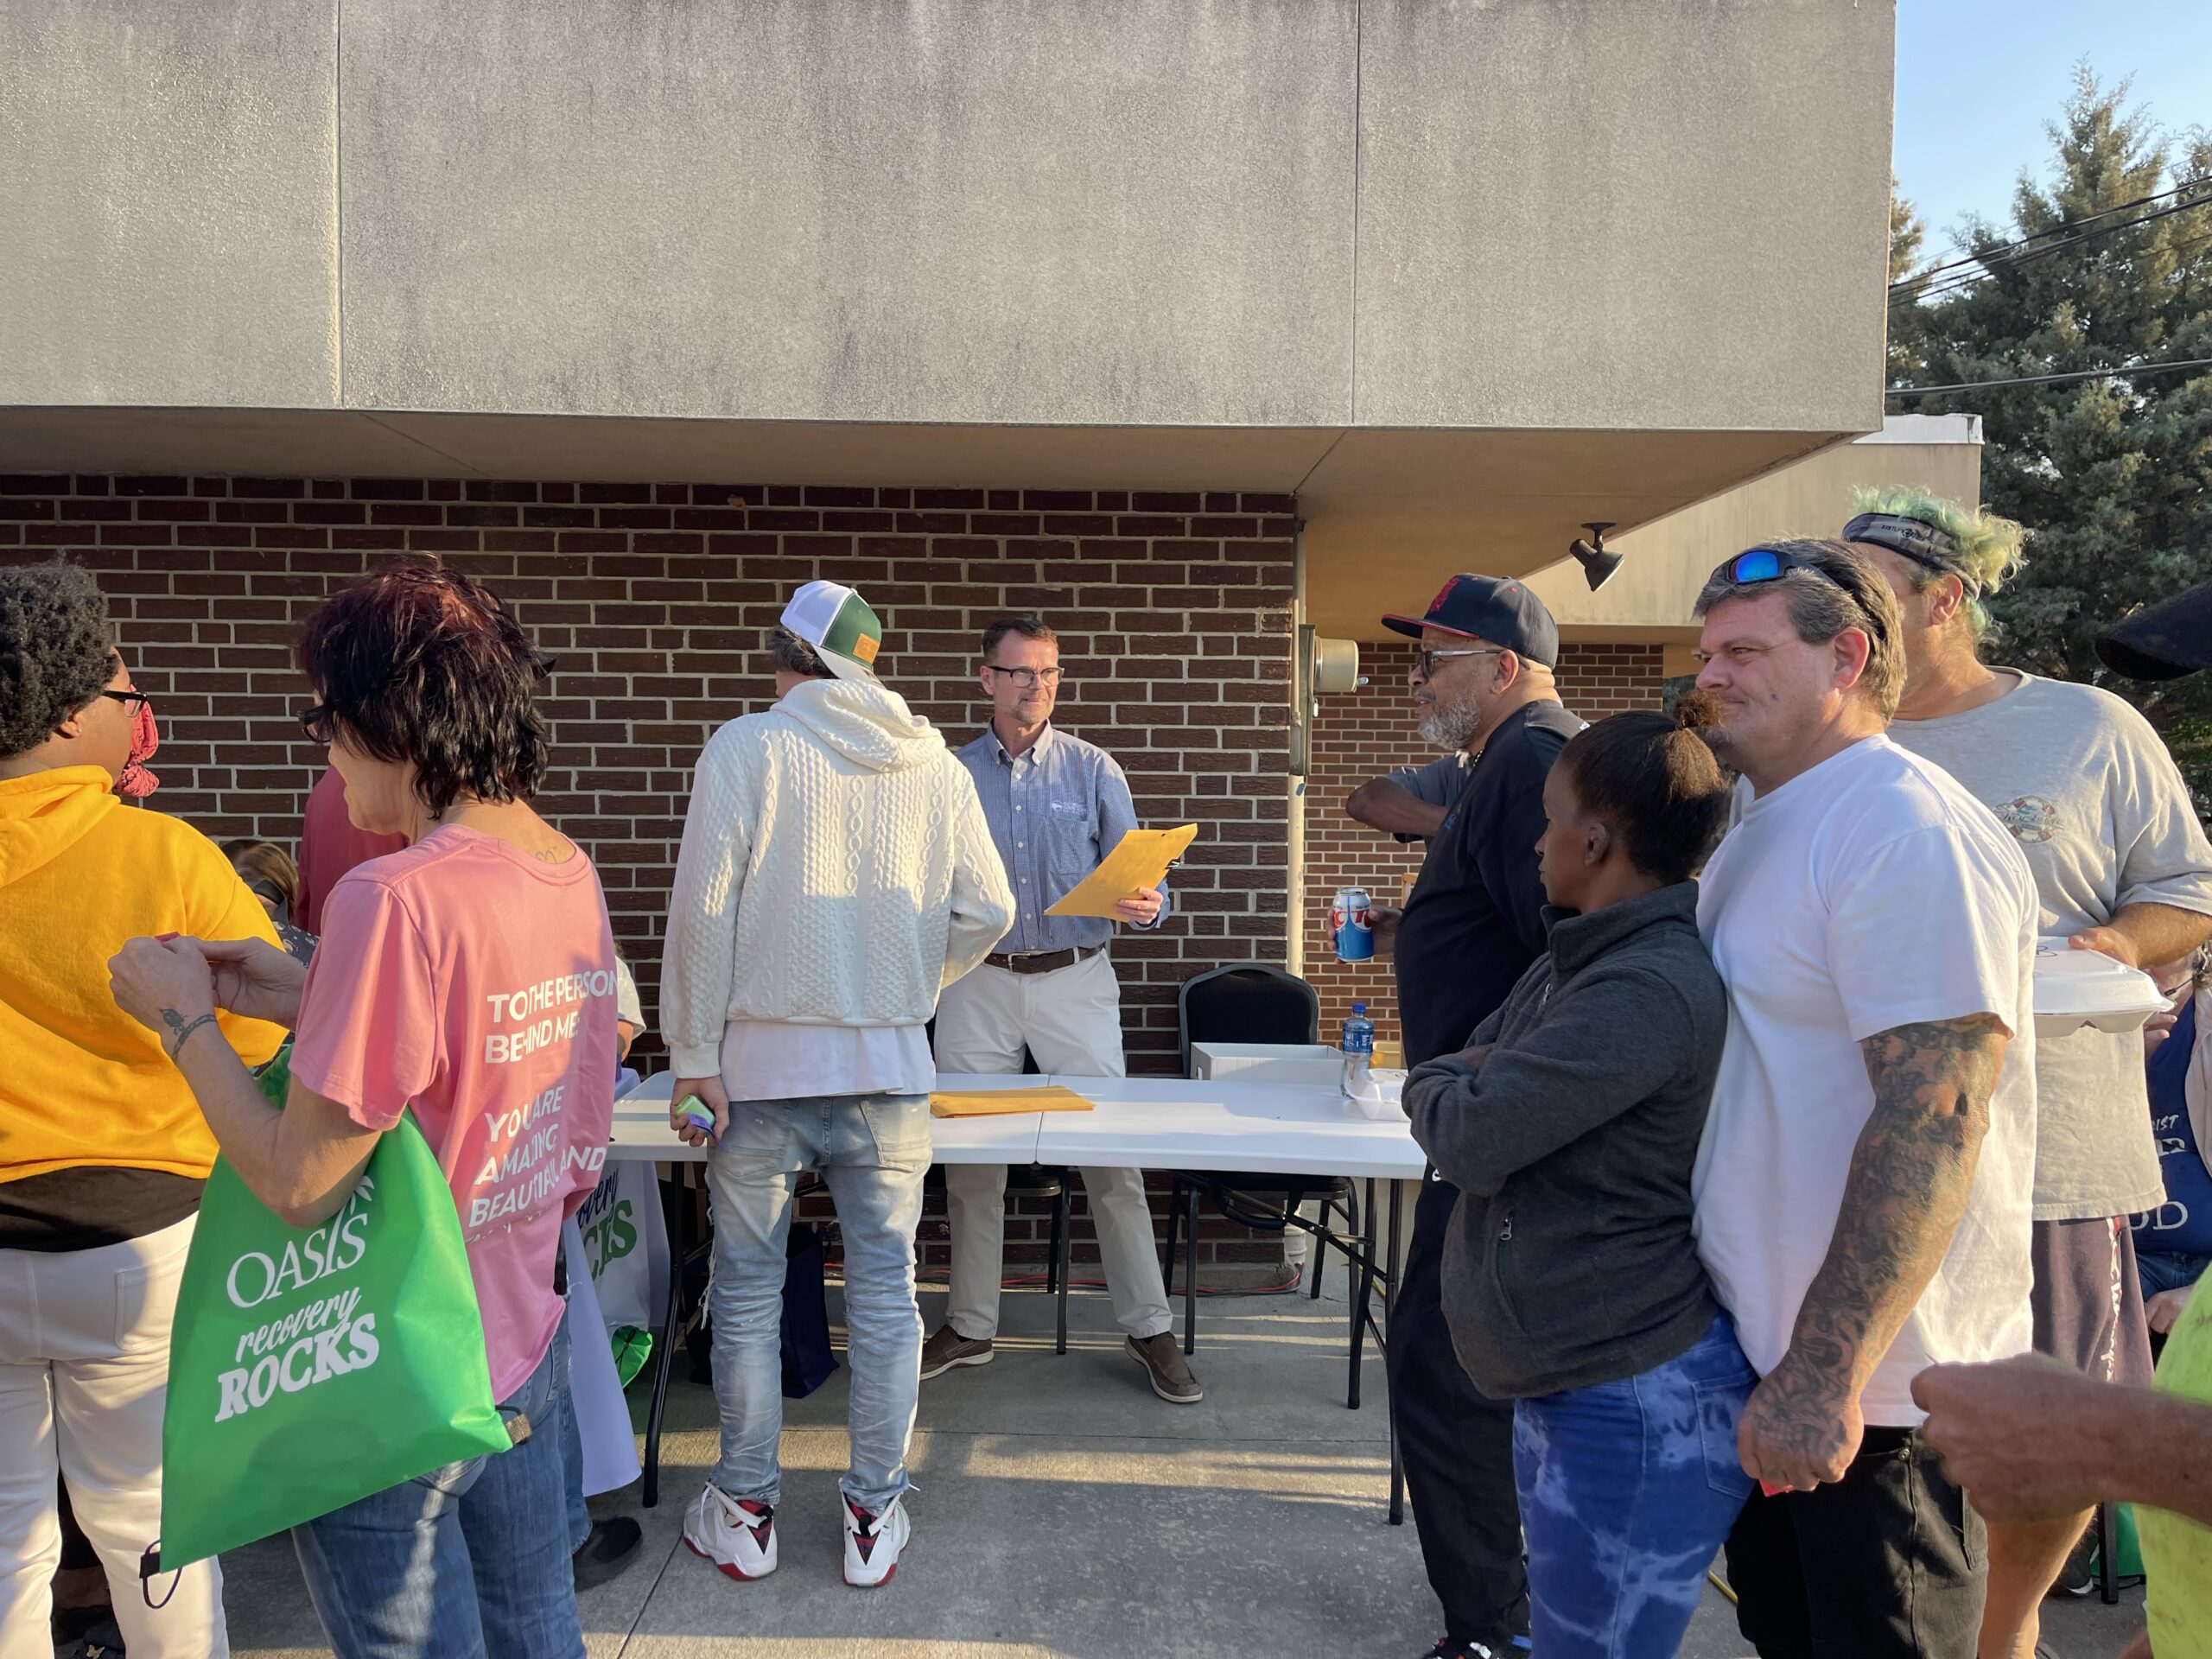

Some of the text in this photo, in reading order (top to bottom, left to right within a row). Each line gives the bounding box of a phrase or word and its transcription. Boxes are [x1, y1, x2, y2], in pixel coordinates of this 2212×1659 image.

[486, 991, 529, 1023] TO
[528, 980, 554, 1014] THE
[485, 1019, 553, 1064] BEHIND
[484, 1084, 565, 1142] YOU ARE
[560, 1145, 607, 1176] AND
[576, 1168, 620, 1230] overy
[226, 1206, 368, 1308] OASIS
[583, 1199, 638, 1281] CKS
[235, 1287, 362, 1363] recovery
[214, 1313, 380, 1423] ROCKS
